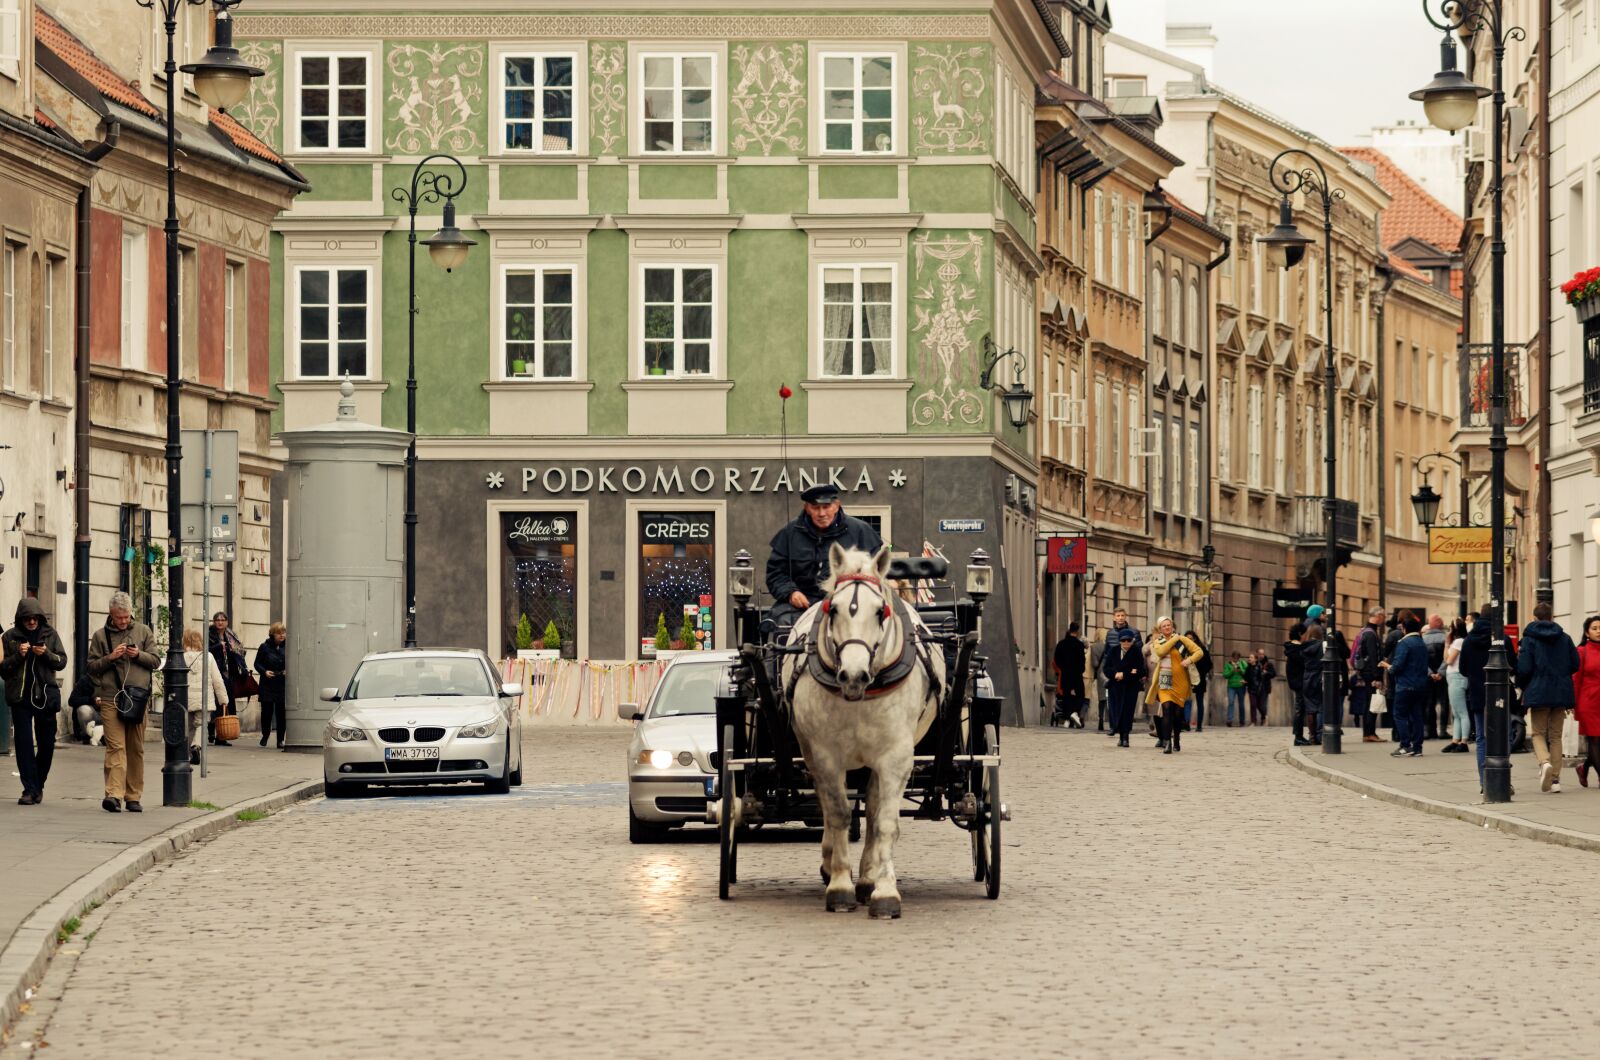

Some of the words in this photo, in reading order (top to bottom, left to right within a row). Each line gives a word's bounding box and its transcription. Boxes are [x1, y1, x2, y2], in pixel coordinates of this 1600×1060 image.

[522, 464, 874, 494] PODKOMORZANKA
[509, 516, 551, 542] Lalka
[645, 520, 710, 538] CRÊPES
[390, 748, 408, 758] WMA
[410, 748, 438, 758] 37196
